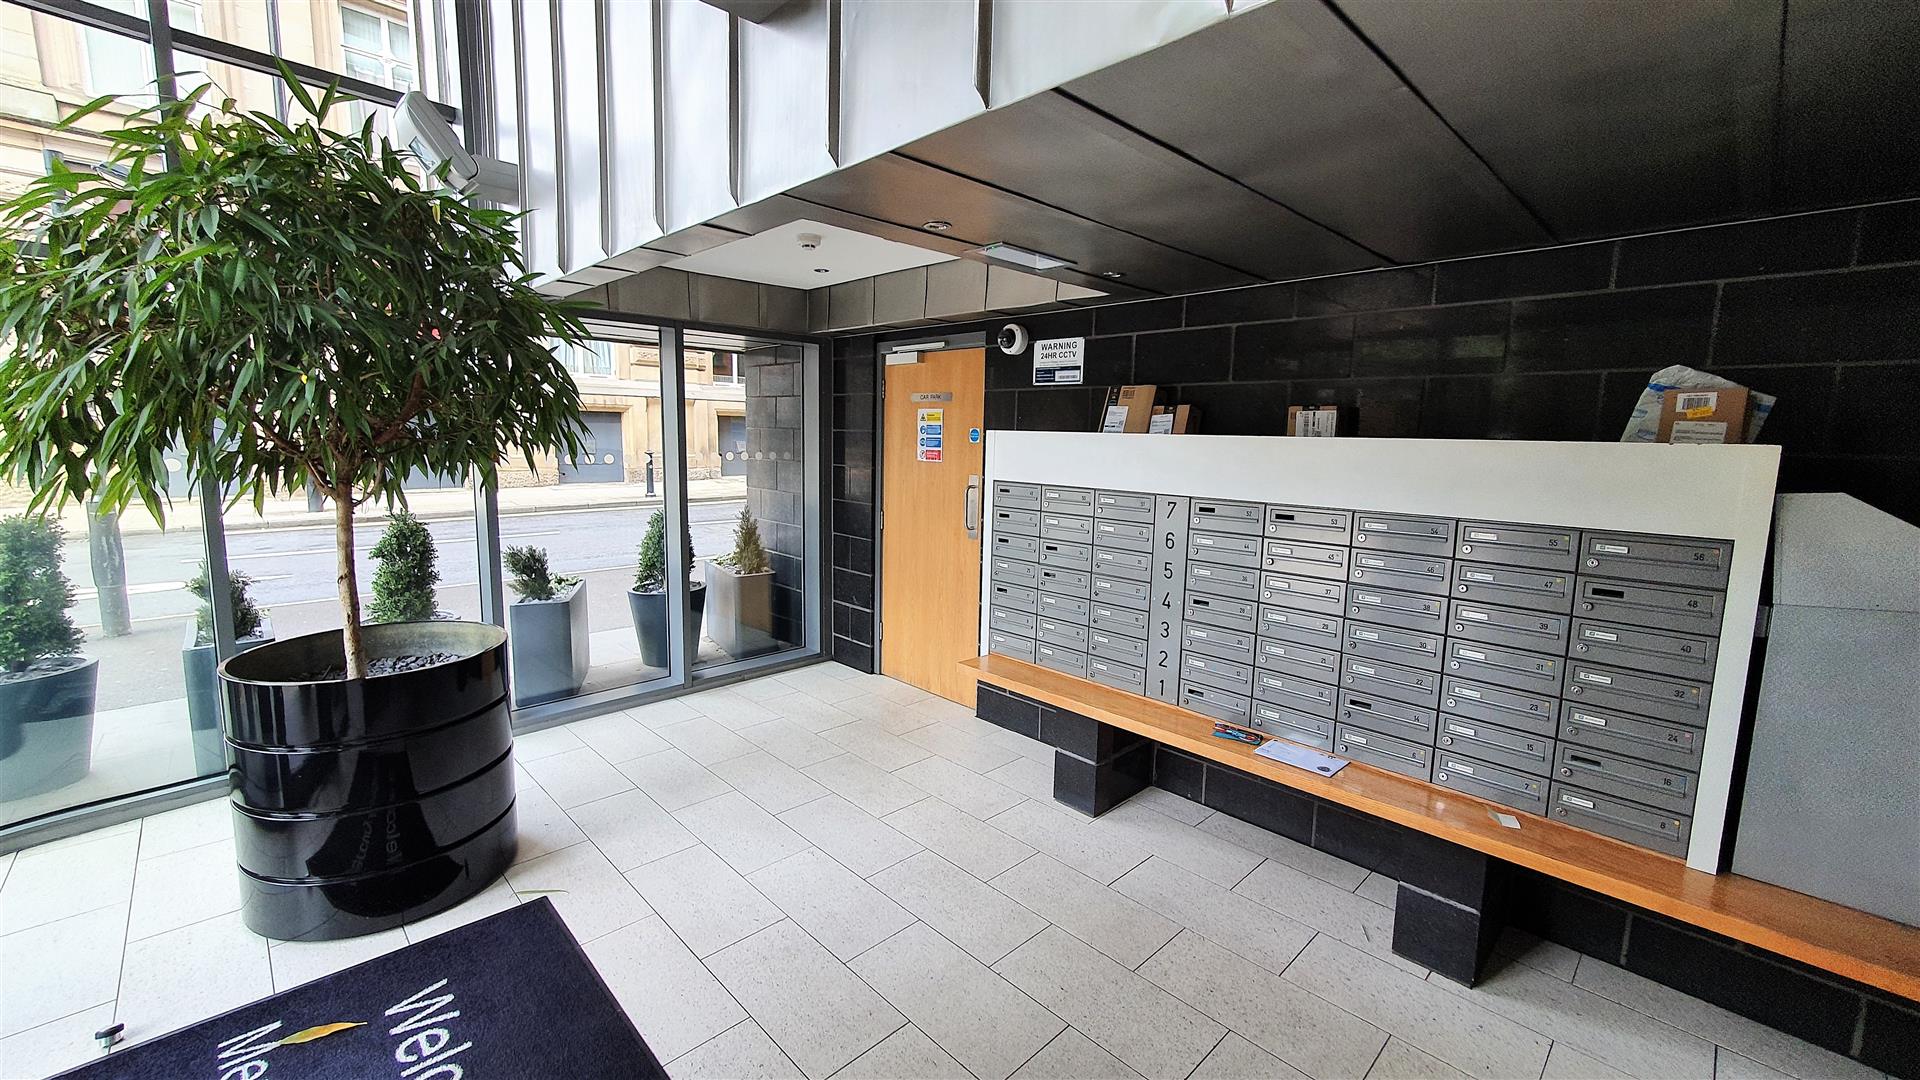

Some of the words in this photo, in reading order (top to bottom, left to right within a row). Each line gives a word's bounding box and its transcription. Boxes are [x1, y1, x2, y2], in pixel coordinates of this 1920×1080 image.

[1041, 341, 1078, 351] WARNING
[1167, 502, 1176, 519] 7
[1165, 532, 1174, 549] 6
[1694, 552, 1704, 561] 56
[1164, 562, 1173, 579] 5
[1162, 592, 1171, 609] 4
[1688, 600, 1698, 608] 48
[1160, 621, 1169, 638] 3
[1680, 645, 1691, 653] 40
[1159, 650, 1168, 668] 2
[1159, 680, 1164, 696] 1
[1674, 690, 1685, 698] 32
[1667, 734, 1678, 743] 24
[1663, 778, 1672, 786] 16
